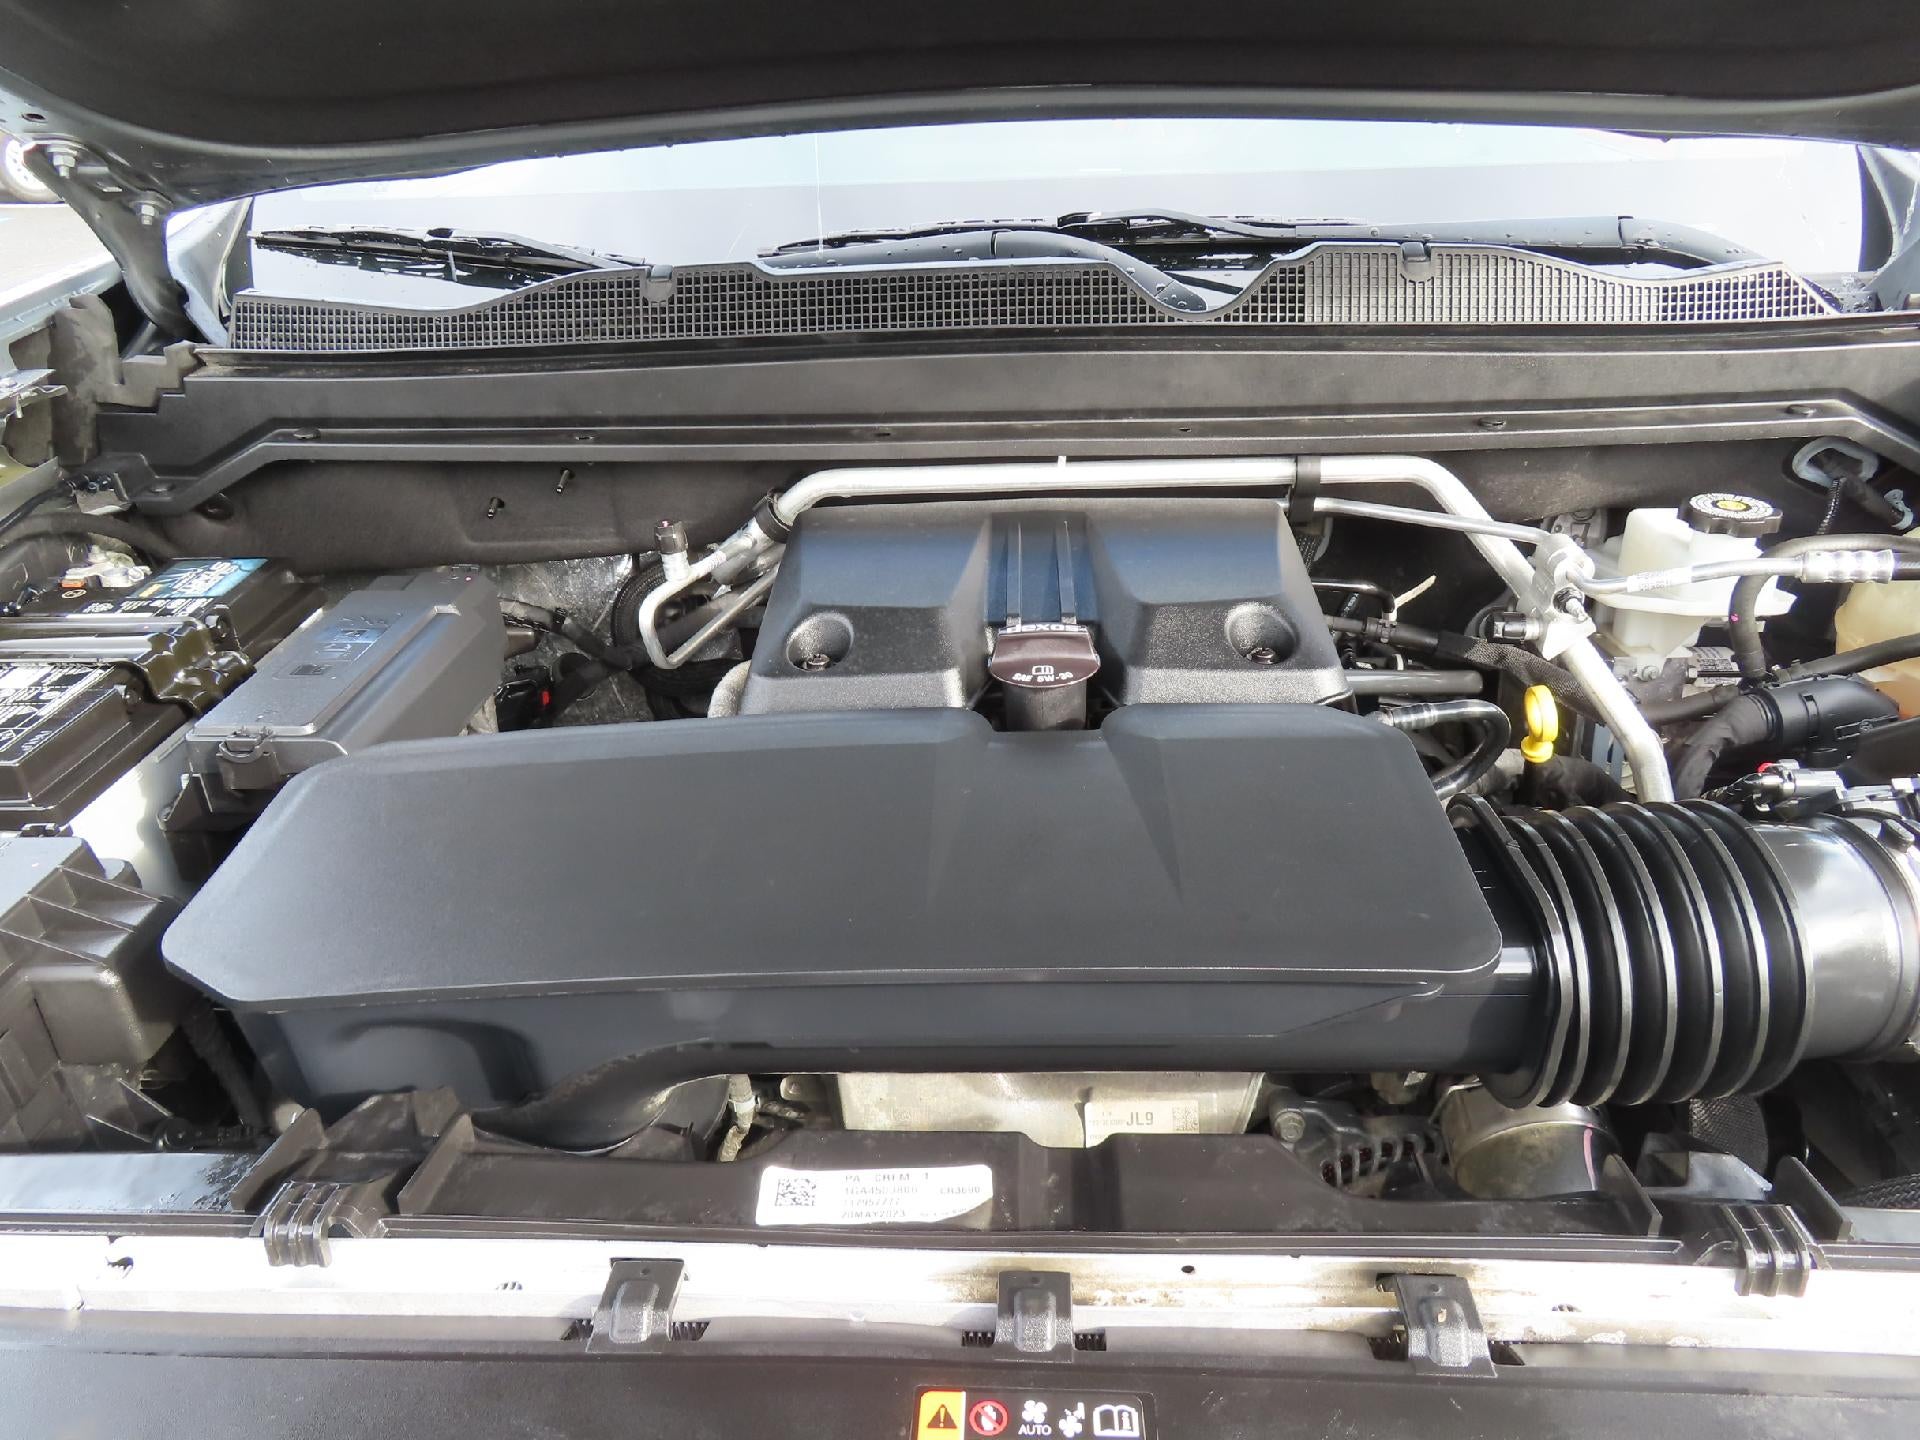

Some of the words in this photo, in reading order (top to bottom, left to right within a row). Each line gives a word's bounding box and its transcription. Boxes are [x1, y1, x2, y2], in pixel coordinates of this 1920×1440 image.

[1006, 624, 1080, 633] dexos
[1012, 672, 1034, 682] SAE
[1126, 1111, 1154, 1126] JL9
[1018, 1425, 1052, 1436] AUTO
